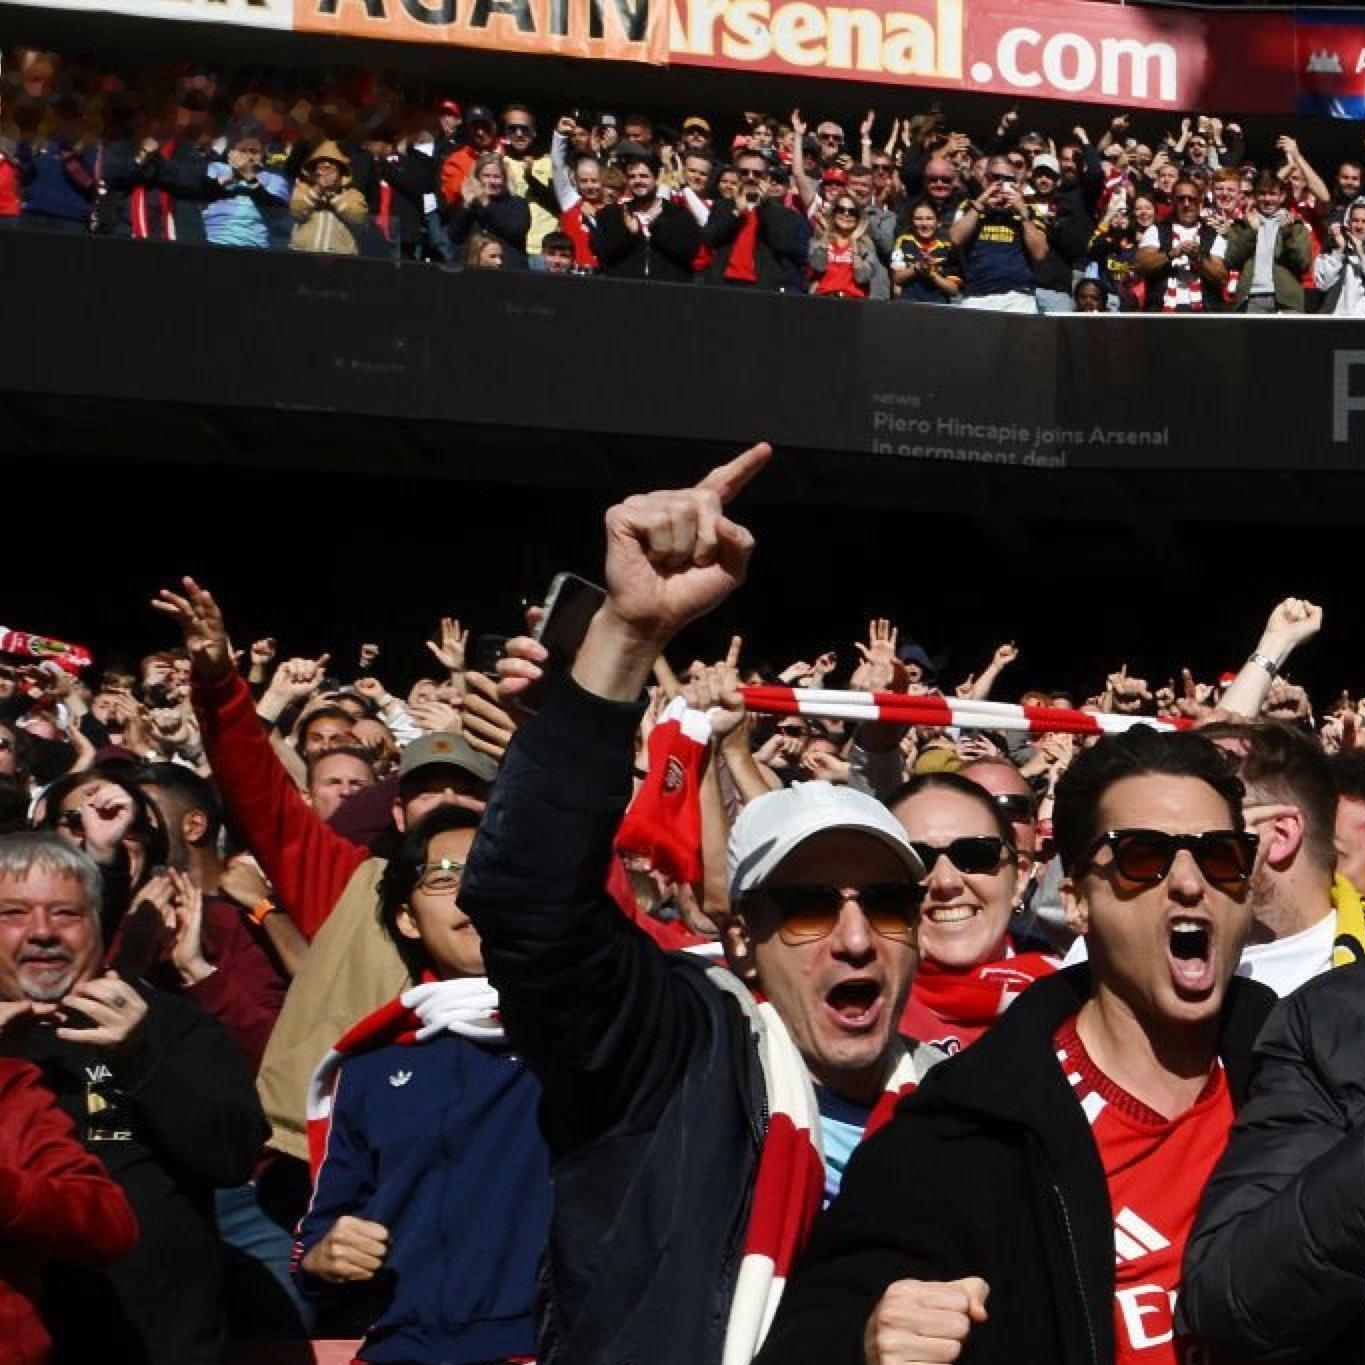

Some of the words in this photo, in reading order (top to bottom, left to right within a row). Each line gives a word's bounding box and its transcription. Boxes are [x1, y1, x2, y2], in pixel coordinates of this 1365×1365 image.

[873, 411, 931, 434] Piero
[1033, 423, 1084, 447] joins
[1088, 425, 1169, 446] Arsenal
